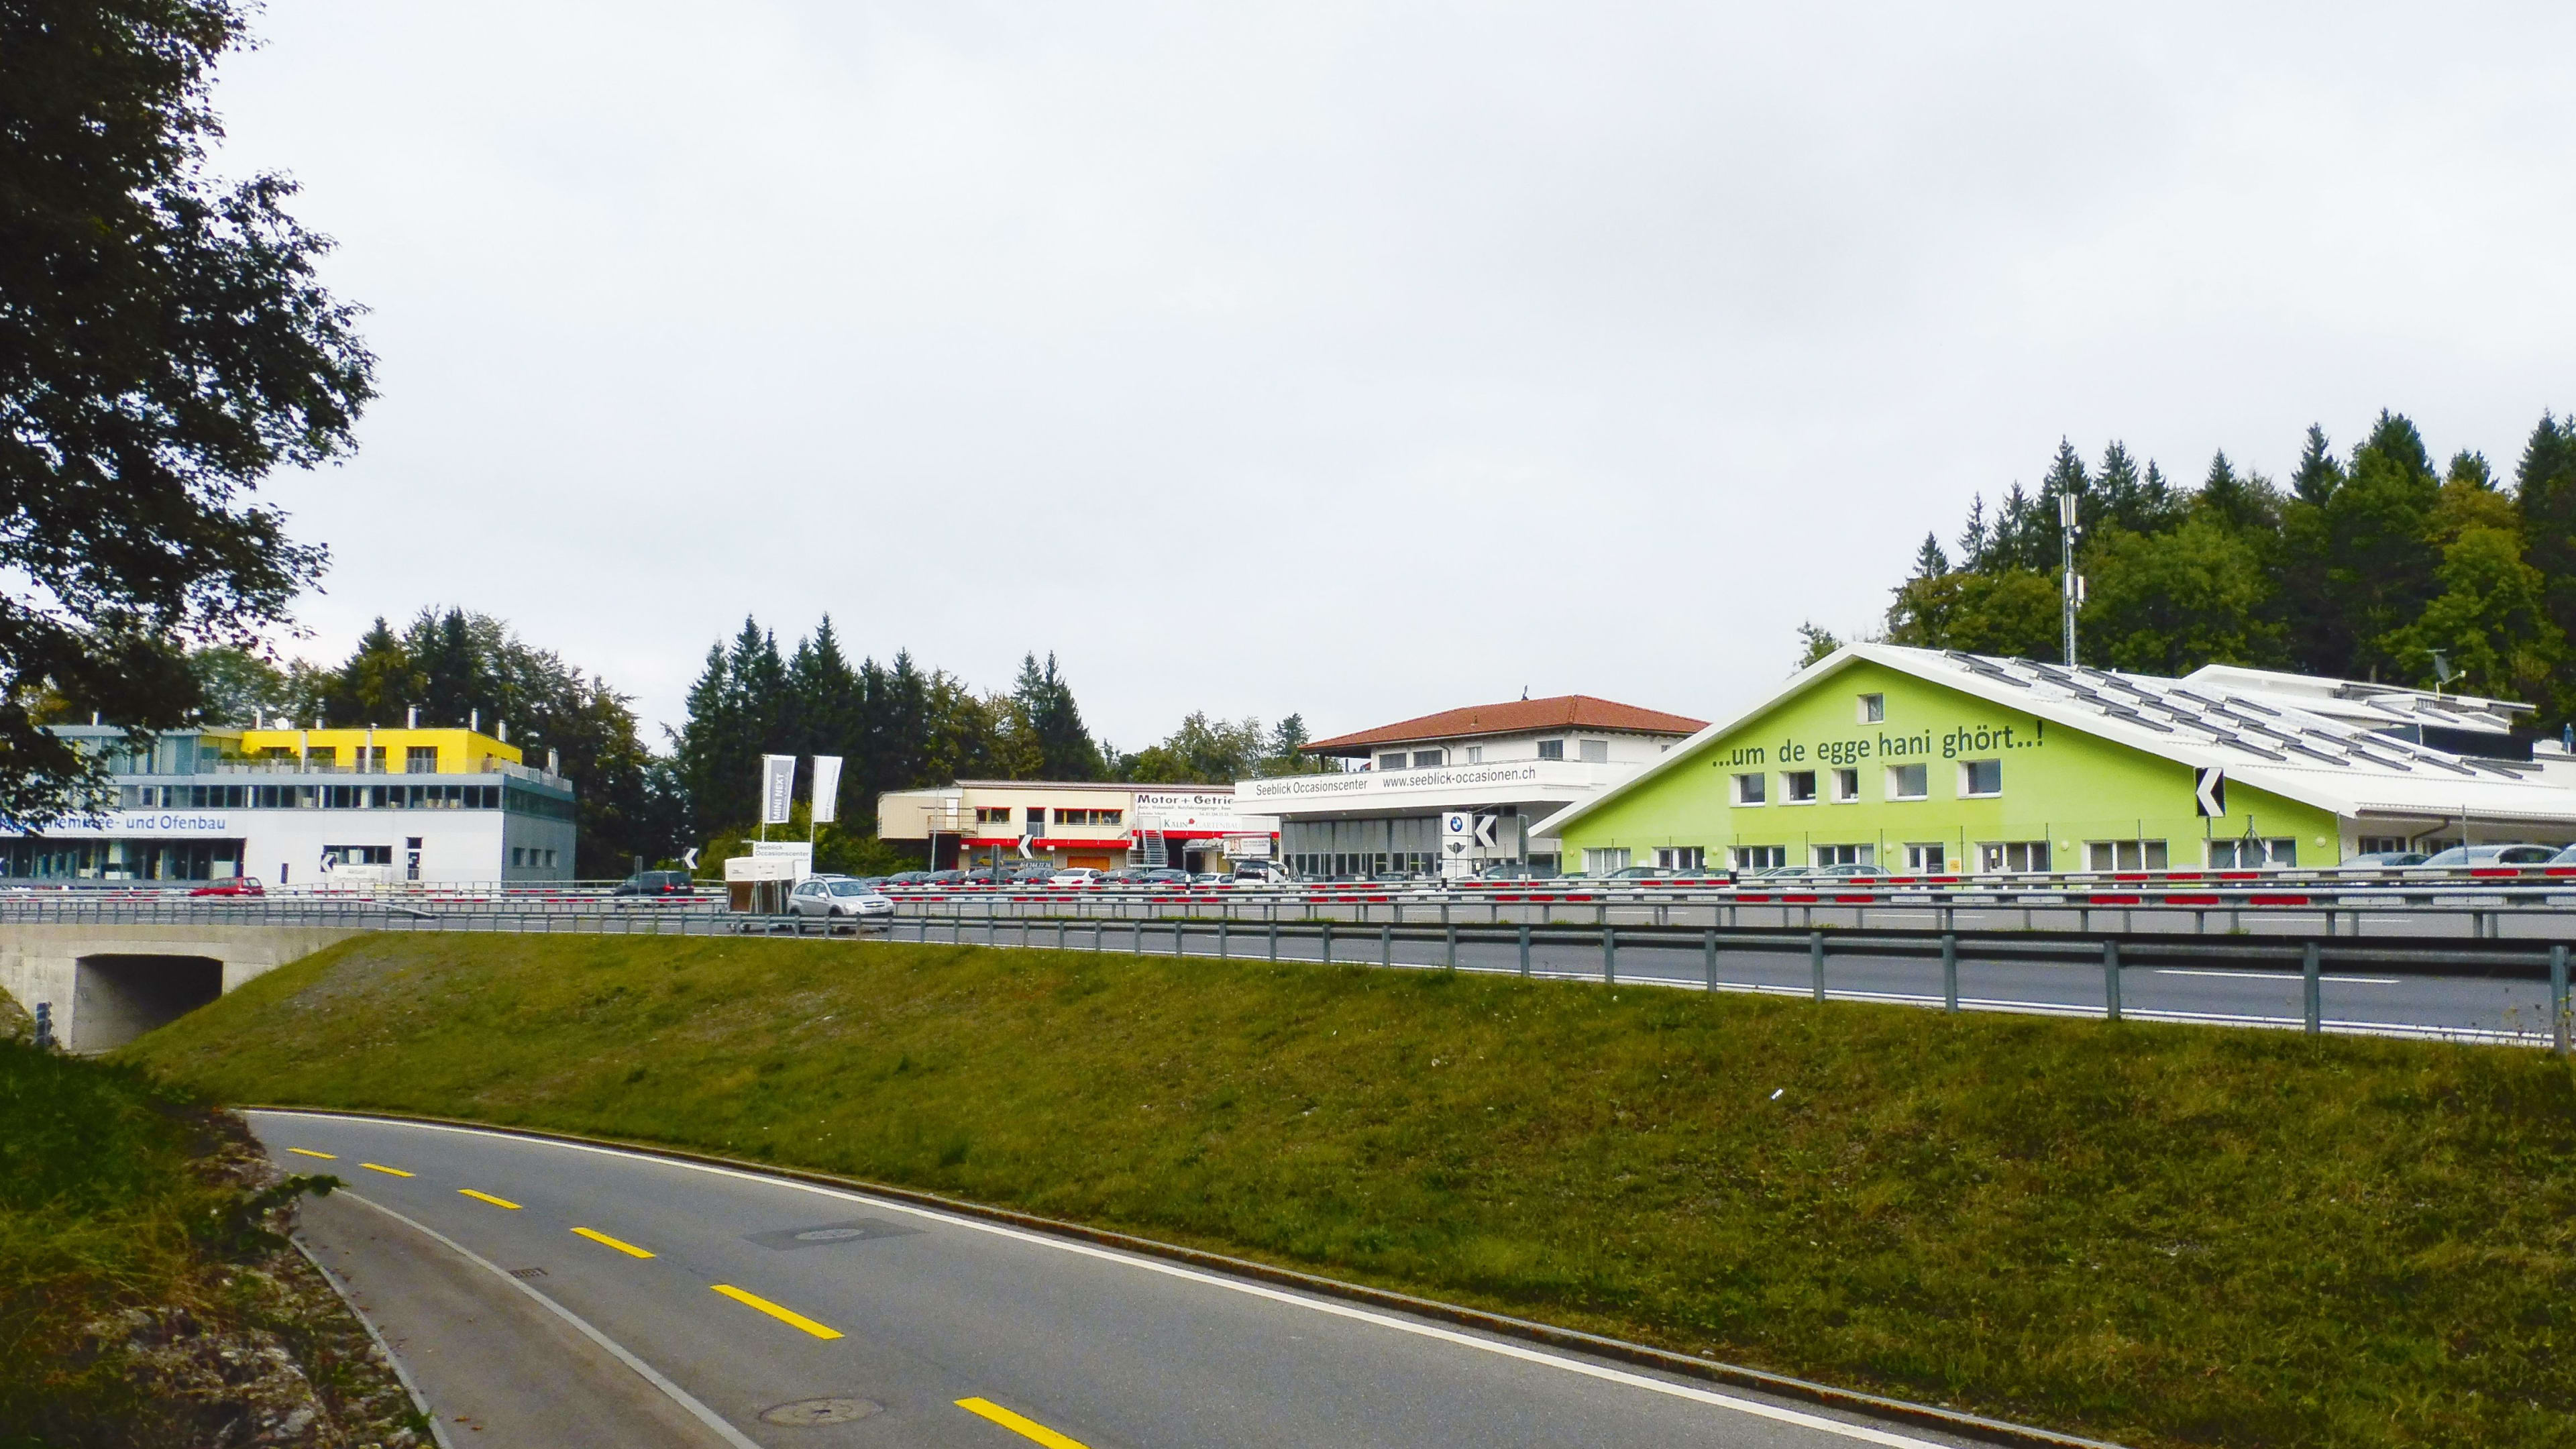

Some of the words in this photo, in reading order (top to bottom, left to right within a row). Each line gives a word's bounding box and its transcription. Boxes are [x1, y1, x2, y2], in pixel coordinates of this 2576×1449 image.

[1712, 747, 1764, 767] ...um
[1778, 739, 1805, 763] de
[1817, 739, 1870, 764] egge
[1878, 729, 1931, 757] hani
[775, 773, 784, 797] NEXT
[1256, 782, 1291, 796] Seeblick
[1293, 779, 1368, 794] Occasionscenter
[1383, 765, 1536, 788] www.seeblick-occasionen.ch
[773, 799, 782, 820] MINI
[1138, 795, 1179, 804] Motor
[126, 815, 155, 828] und
[160, 815, 225, 829] Ofenbau
